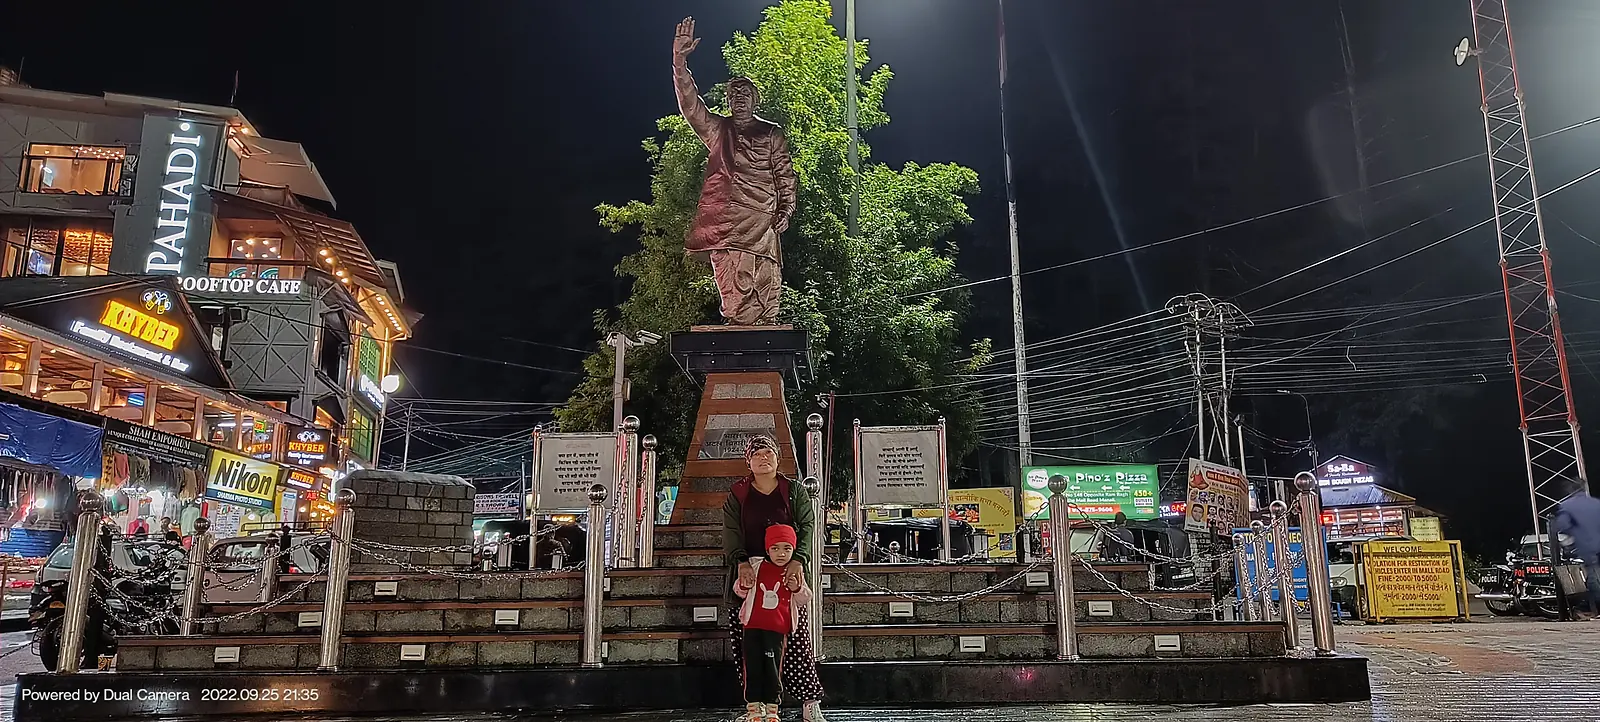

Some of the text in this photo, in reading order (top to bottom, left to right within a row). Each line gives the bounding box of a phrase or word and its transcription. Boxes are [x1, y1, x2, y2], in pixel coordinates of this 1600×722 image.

[146, 133, 201, 274] PAHADI
[255, 278, 302, 294] CAFE
[101, 299, 180, 350] KHYBER
[128, 426, 191, 450] SHAH EMPORIUM
[288, 442, 324, 453] KHYBER
[214, 458, 272, 495] Nikon
[291, 472, 314, 484] KHYBER
[1075, 472, 1110, 483] Pino'z
[1116, 472, 1148, 484] Pizza
[217, 492, 234, 500] SHARMA
